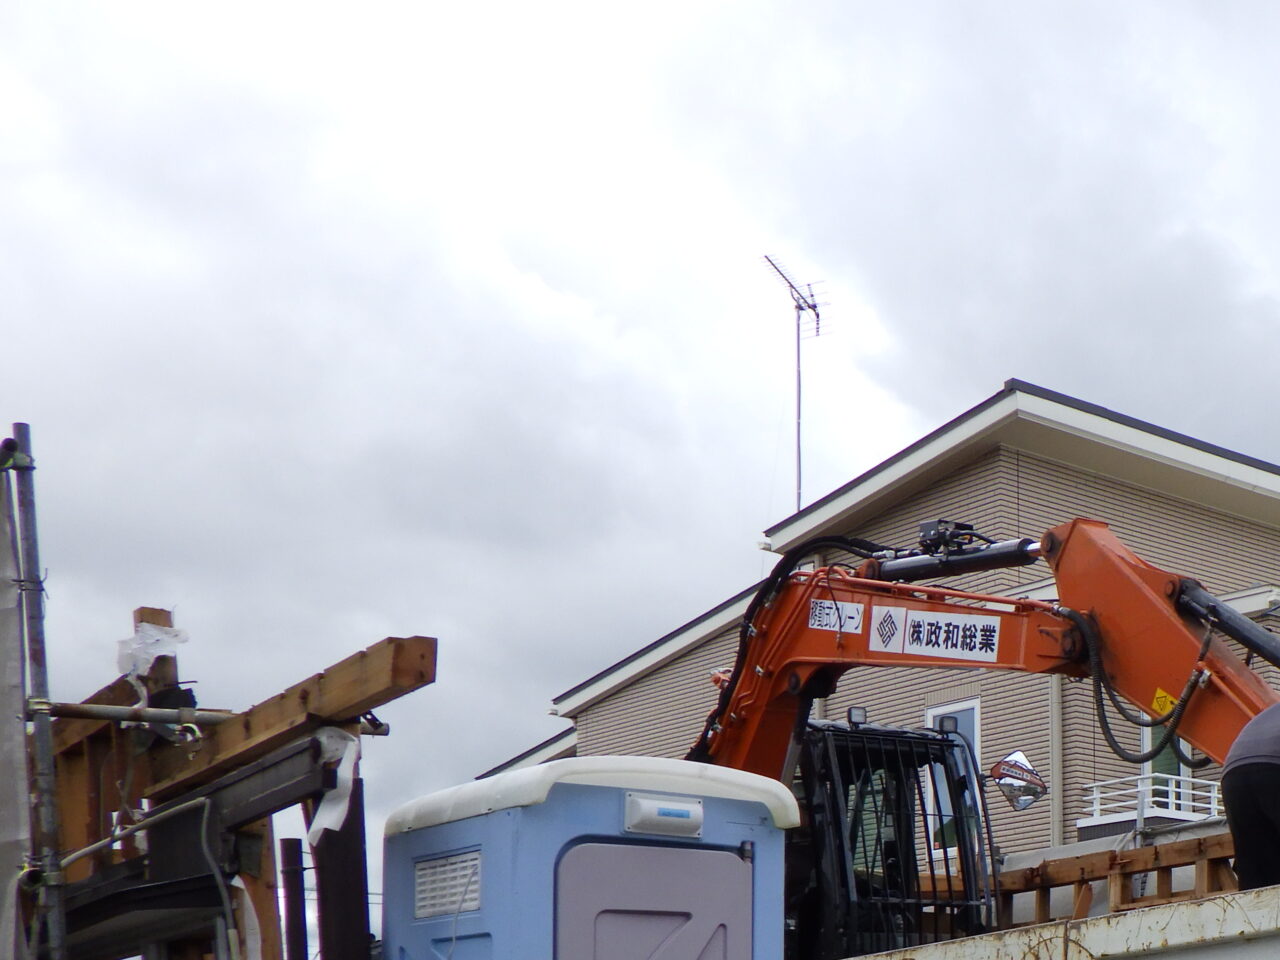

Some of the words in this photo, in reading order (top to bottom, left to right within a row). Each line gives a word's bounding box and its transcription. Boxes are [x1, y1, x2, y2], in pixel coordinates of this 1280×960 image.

[908, 618, 997, 654] (株)政和総業
